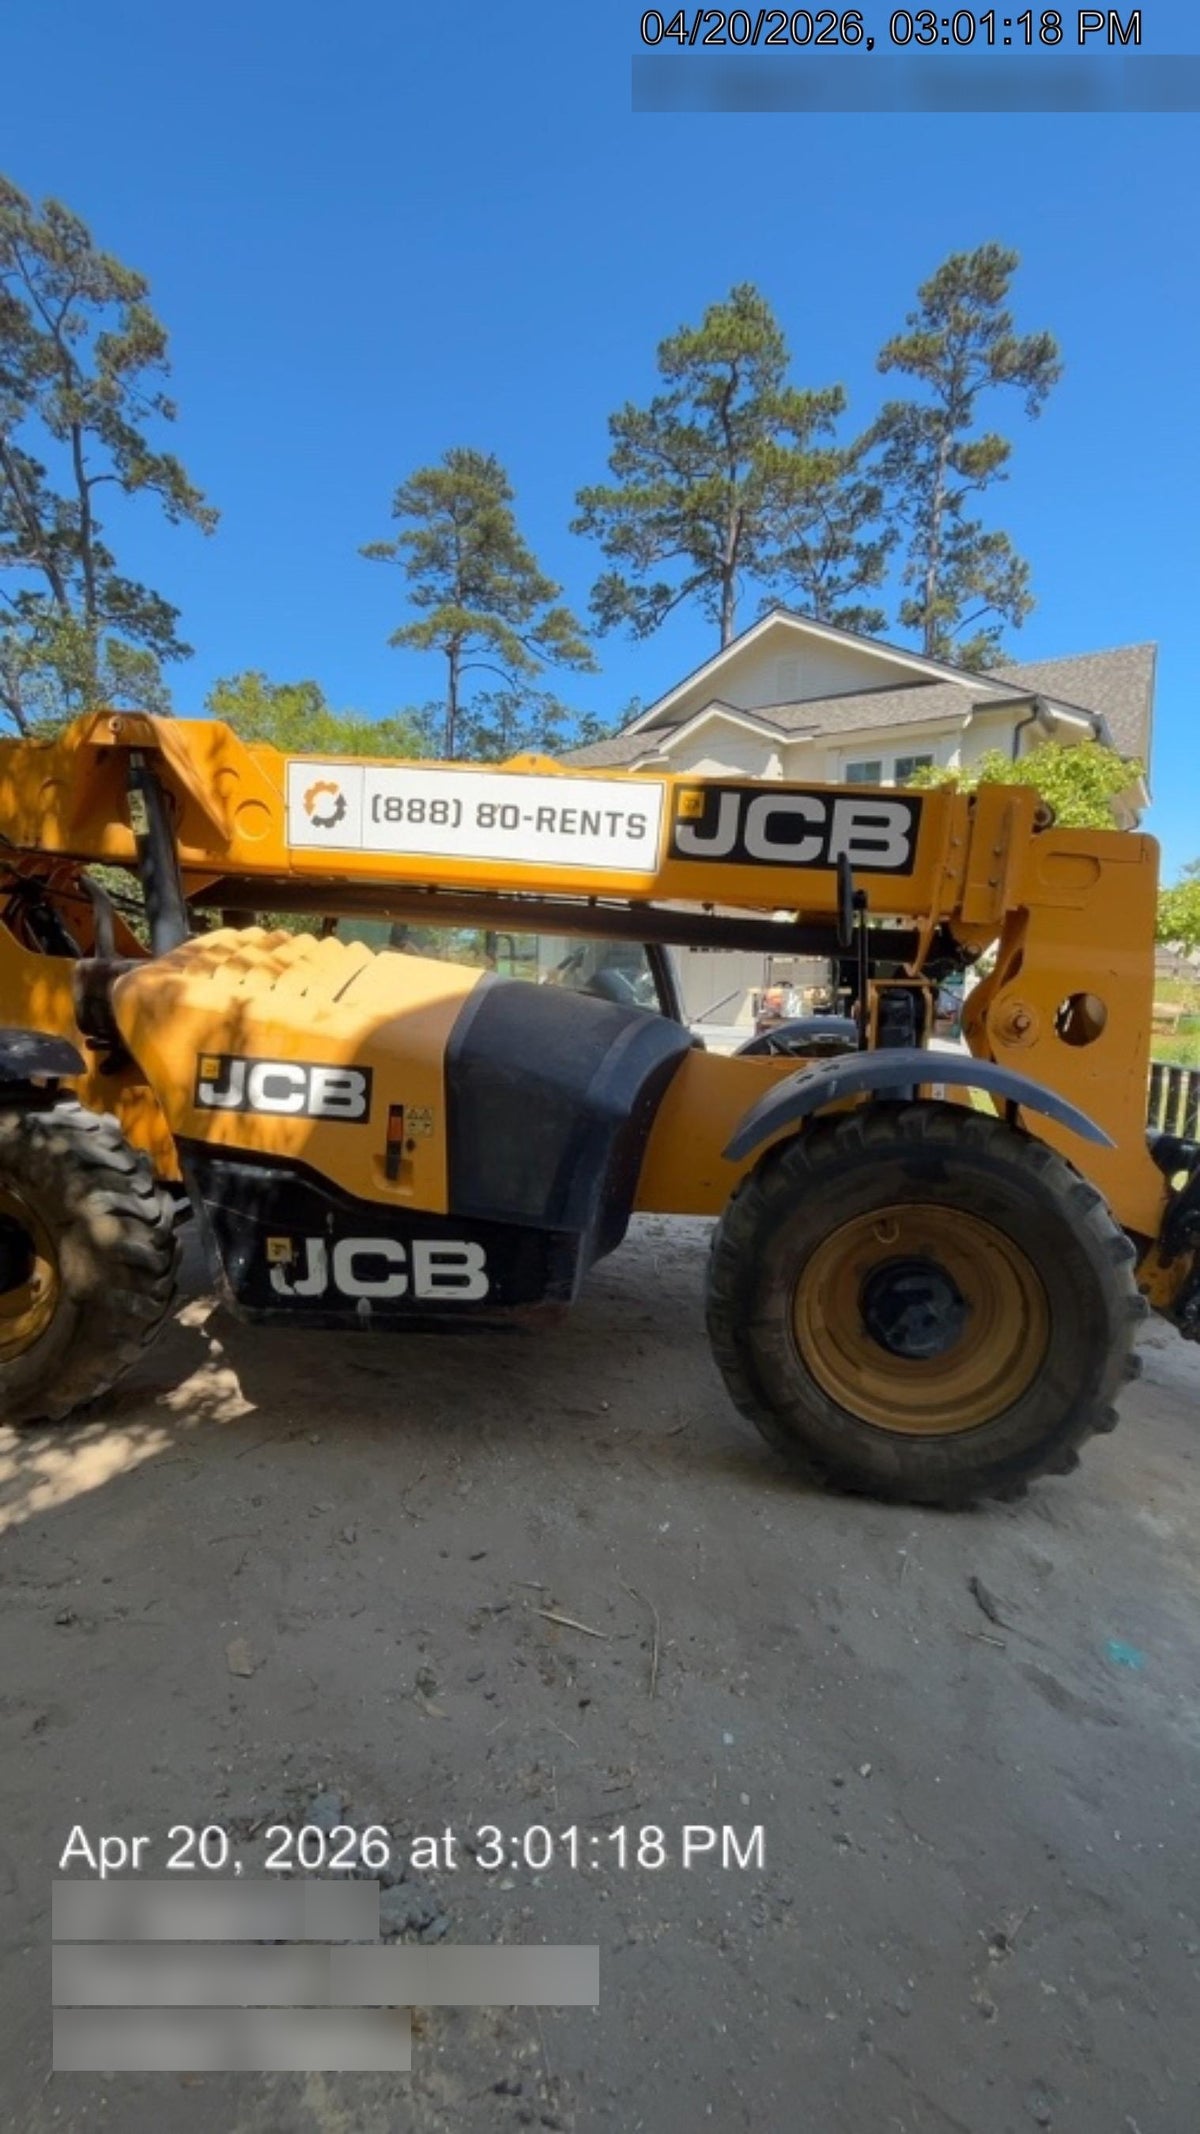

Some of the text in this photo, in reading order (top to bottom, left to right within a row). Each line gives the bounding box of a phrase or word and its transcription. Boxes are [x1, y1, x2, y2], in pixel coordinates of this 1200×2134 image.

[371, 794, 647, 841] (888) 80-RENTS
[674, 791, 913, 868] JCB
[199, 1058, 367, 1119] JCB
[269, 1236, 490, 1301] JCB
